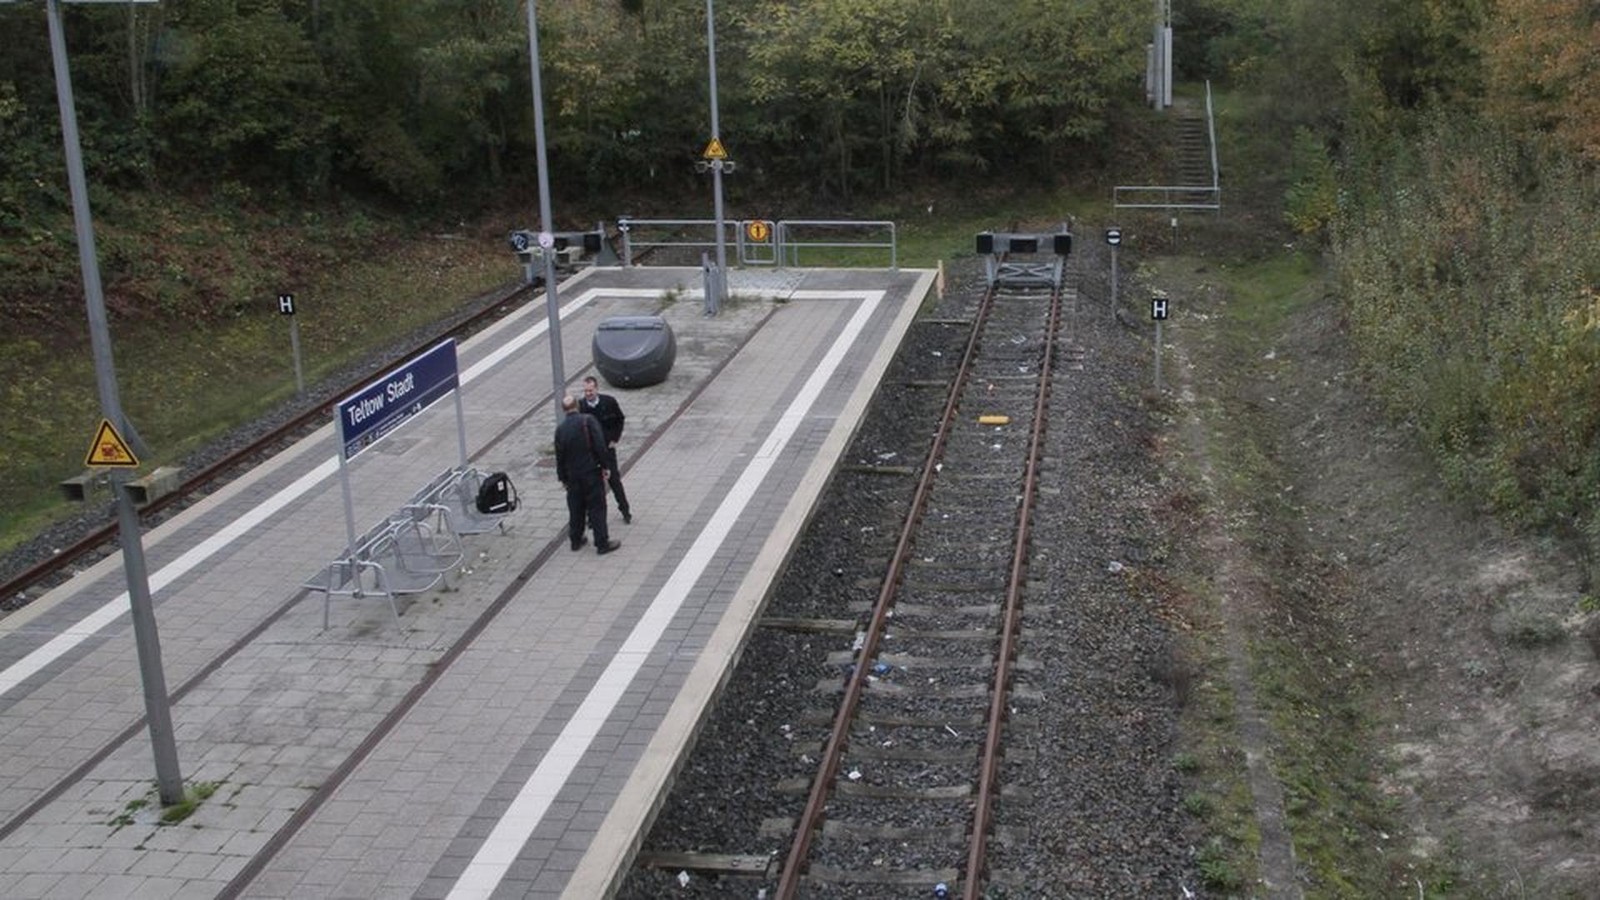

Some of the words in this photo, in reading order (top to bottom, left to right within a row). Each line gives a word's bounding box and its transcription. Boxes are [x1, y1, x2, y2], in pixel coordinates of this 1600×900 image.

[279, 296, 293, 313] H
[1153, 300, 1166, 318] H
[347, 393, 385, 426] Teltow
[386, 372, 415, 403] Stadt
